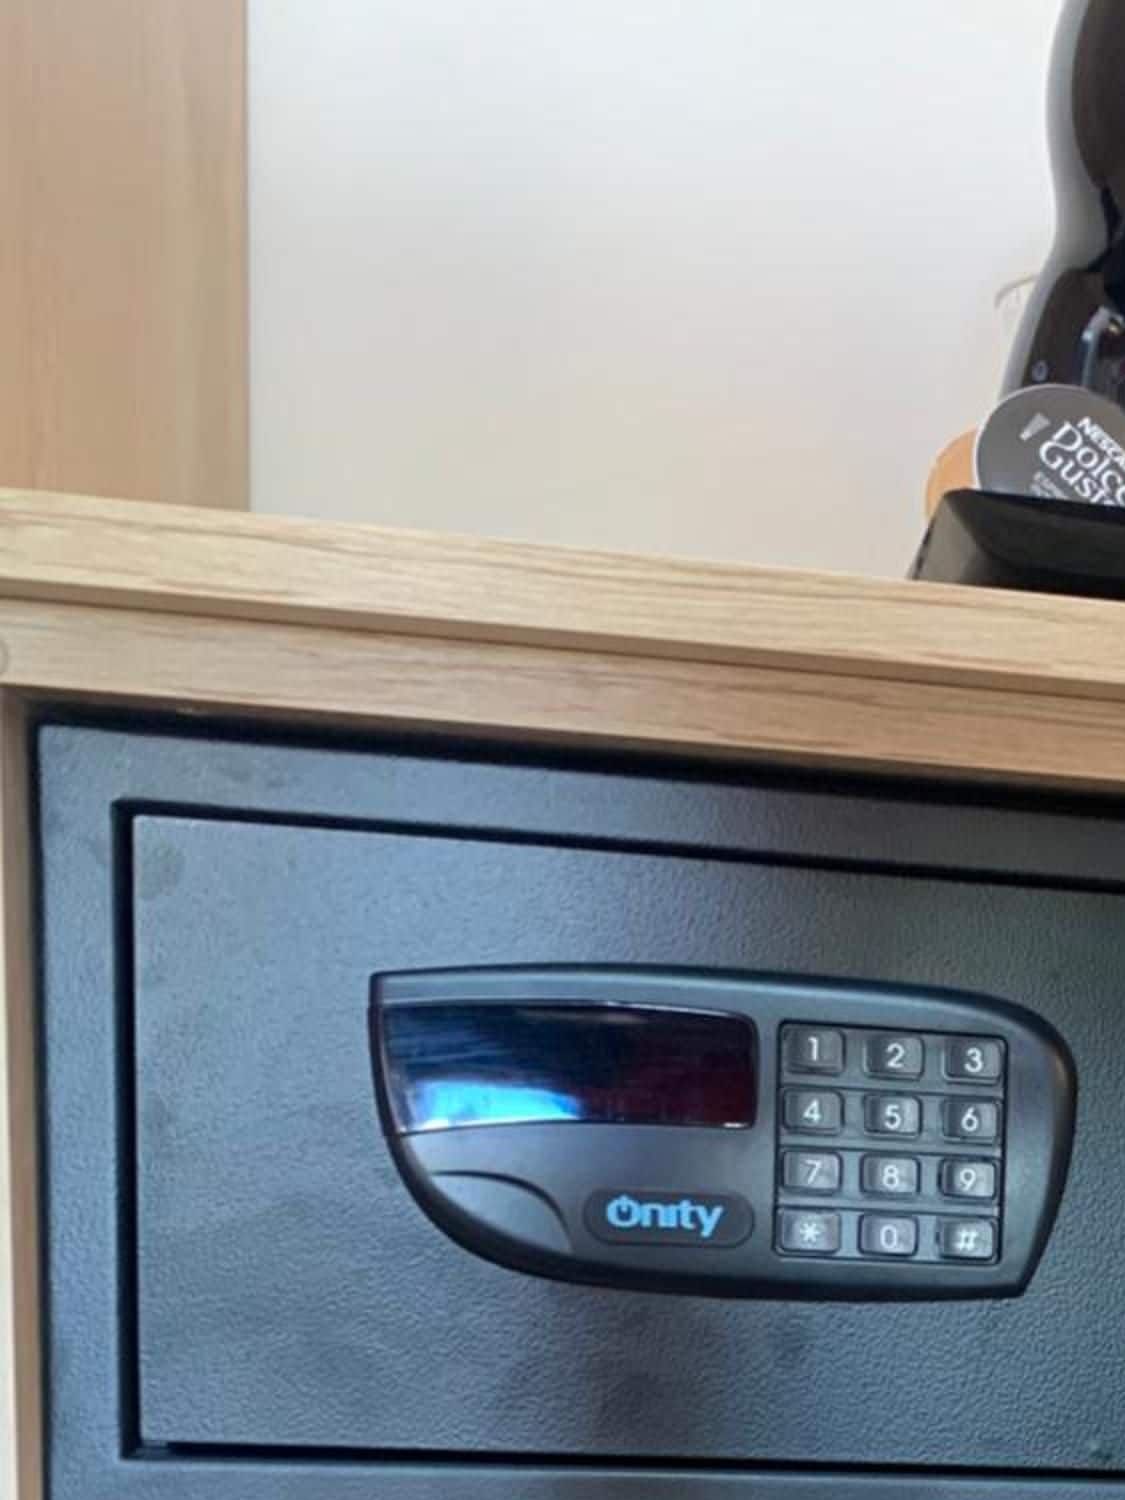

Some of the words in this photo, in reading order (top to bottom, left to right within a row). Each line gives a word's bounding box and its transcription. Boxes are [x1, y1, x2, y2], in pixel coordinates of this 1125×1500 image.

[807, 1035, 819, 1061] 1
[885, 1042, 905, 1069] 2
[963, 1047, 984, 1073] 3
[802, 1099, 821, 1123] 4
[884, 1104, 902, 1129] 5
[960, 1107, 979, 1132] 6
[805, 1159, 822, 1185] 7
[882, 1164, 900, 1189] 8
[959, 1168, 976, 1191] 9
[607, 1194, 724, 1238] Onity
[880, 1224, 897, 1250] 0
[957, 1229, 979, 1251] #
